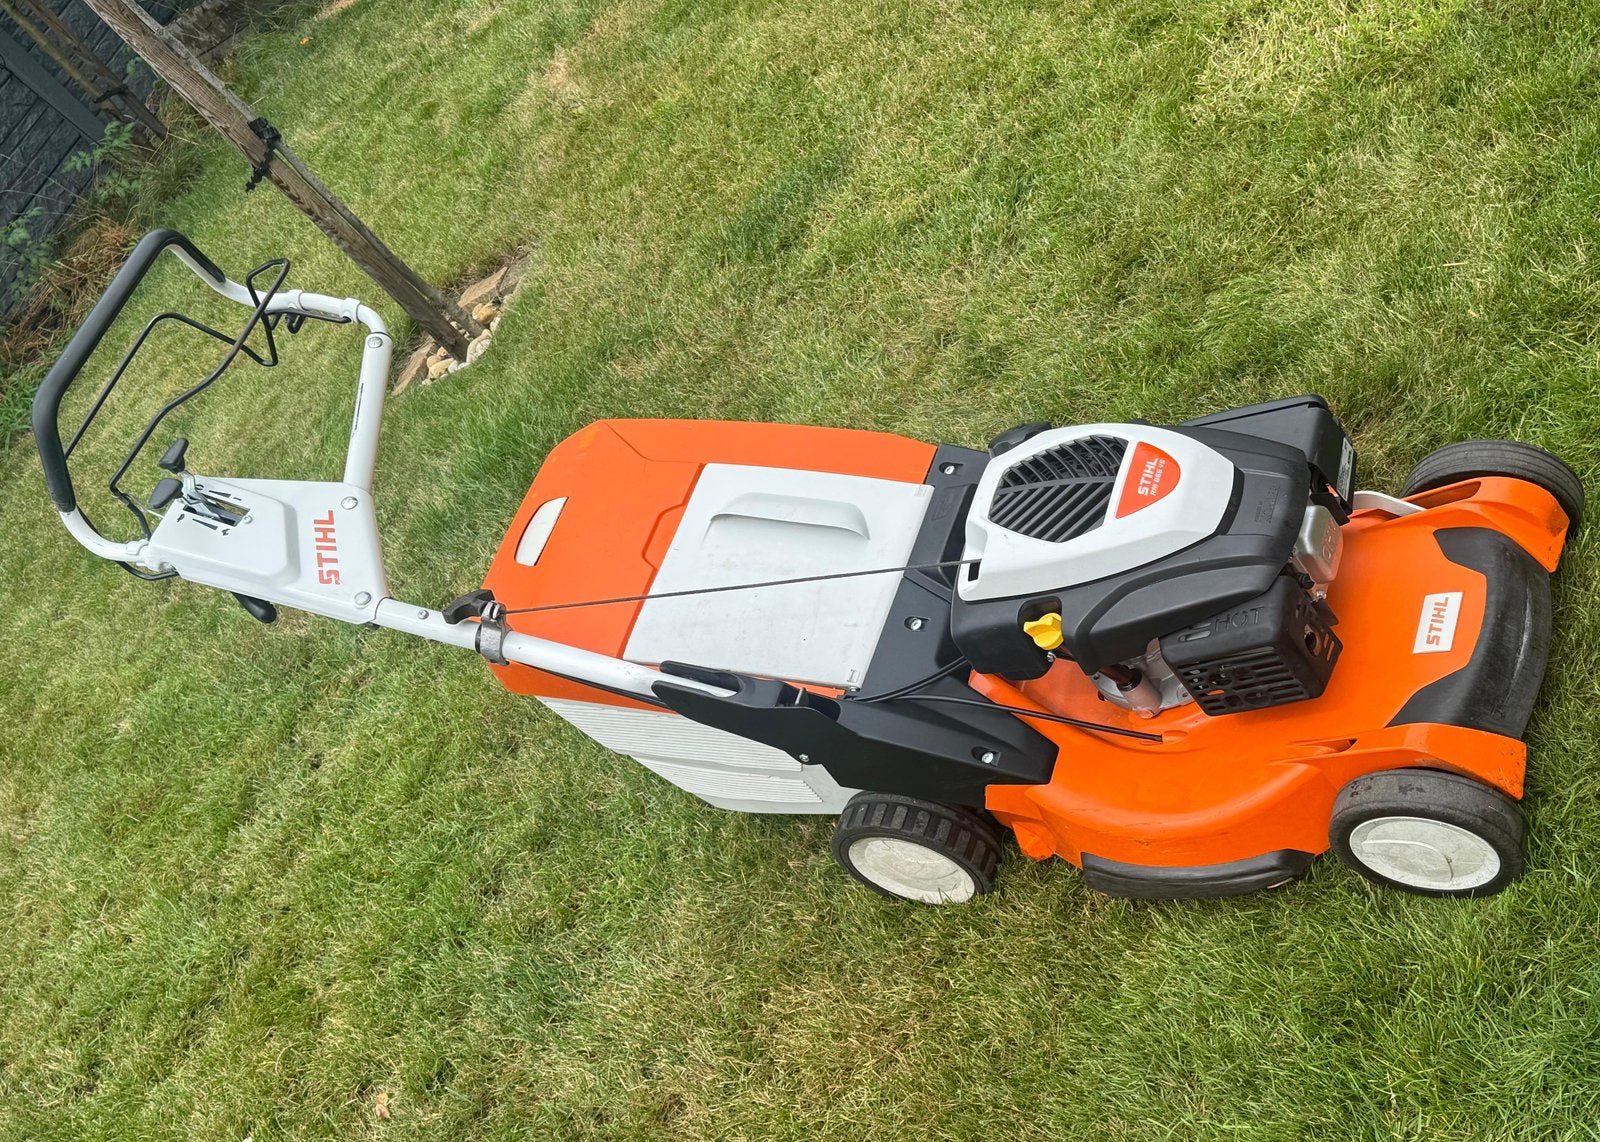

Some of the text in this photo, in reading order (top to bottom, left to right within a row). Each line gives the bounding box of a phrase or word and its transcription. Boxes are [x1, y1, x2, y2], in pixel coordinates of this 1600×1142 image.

[1138, 458, 1158, 496] STIHL
[1150, 484, 1158, 496] RM
[314, 510, 340, 585] STIHL
[1215, 606, 1264, 632] HOT
[1426, 597, 1449, 646] STIHL
